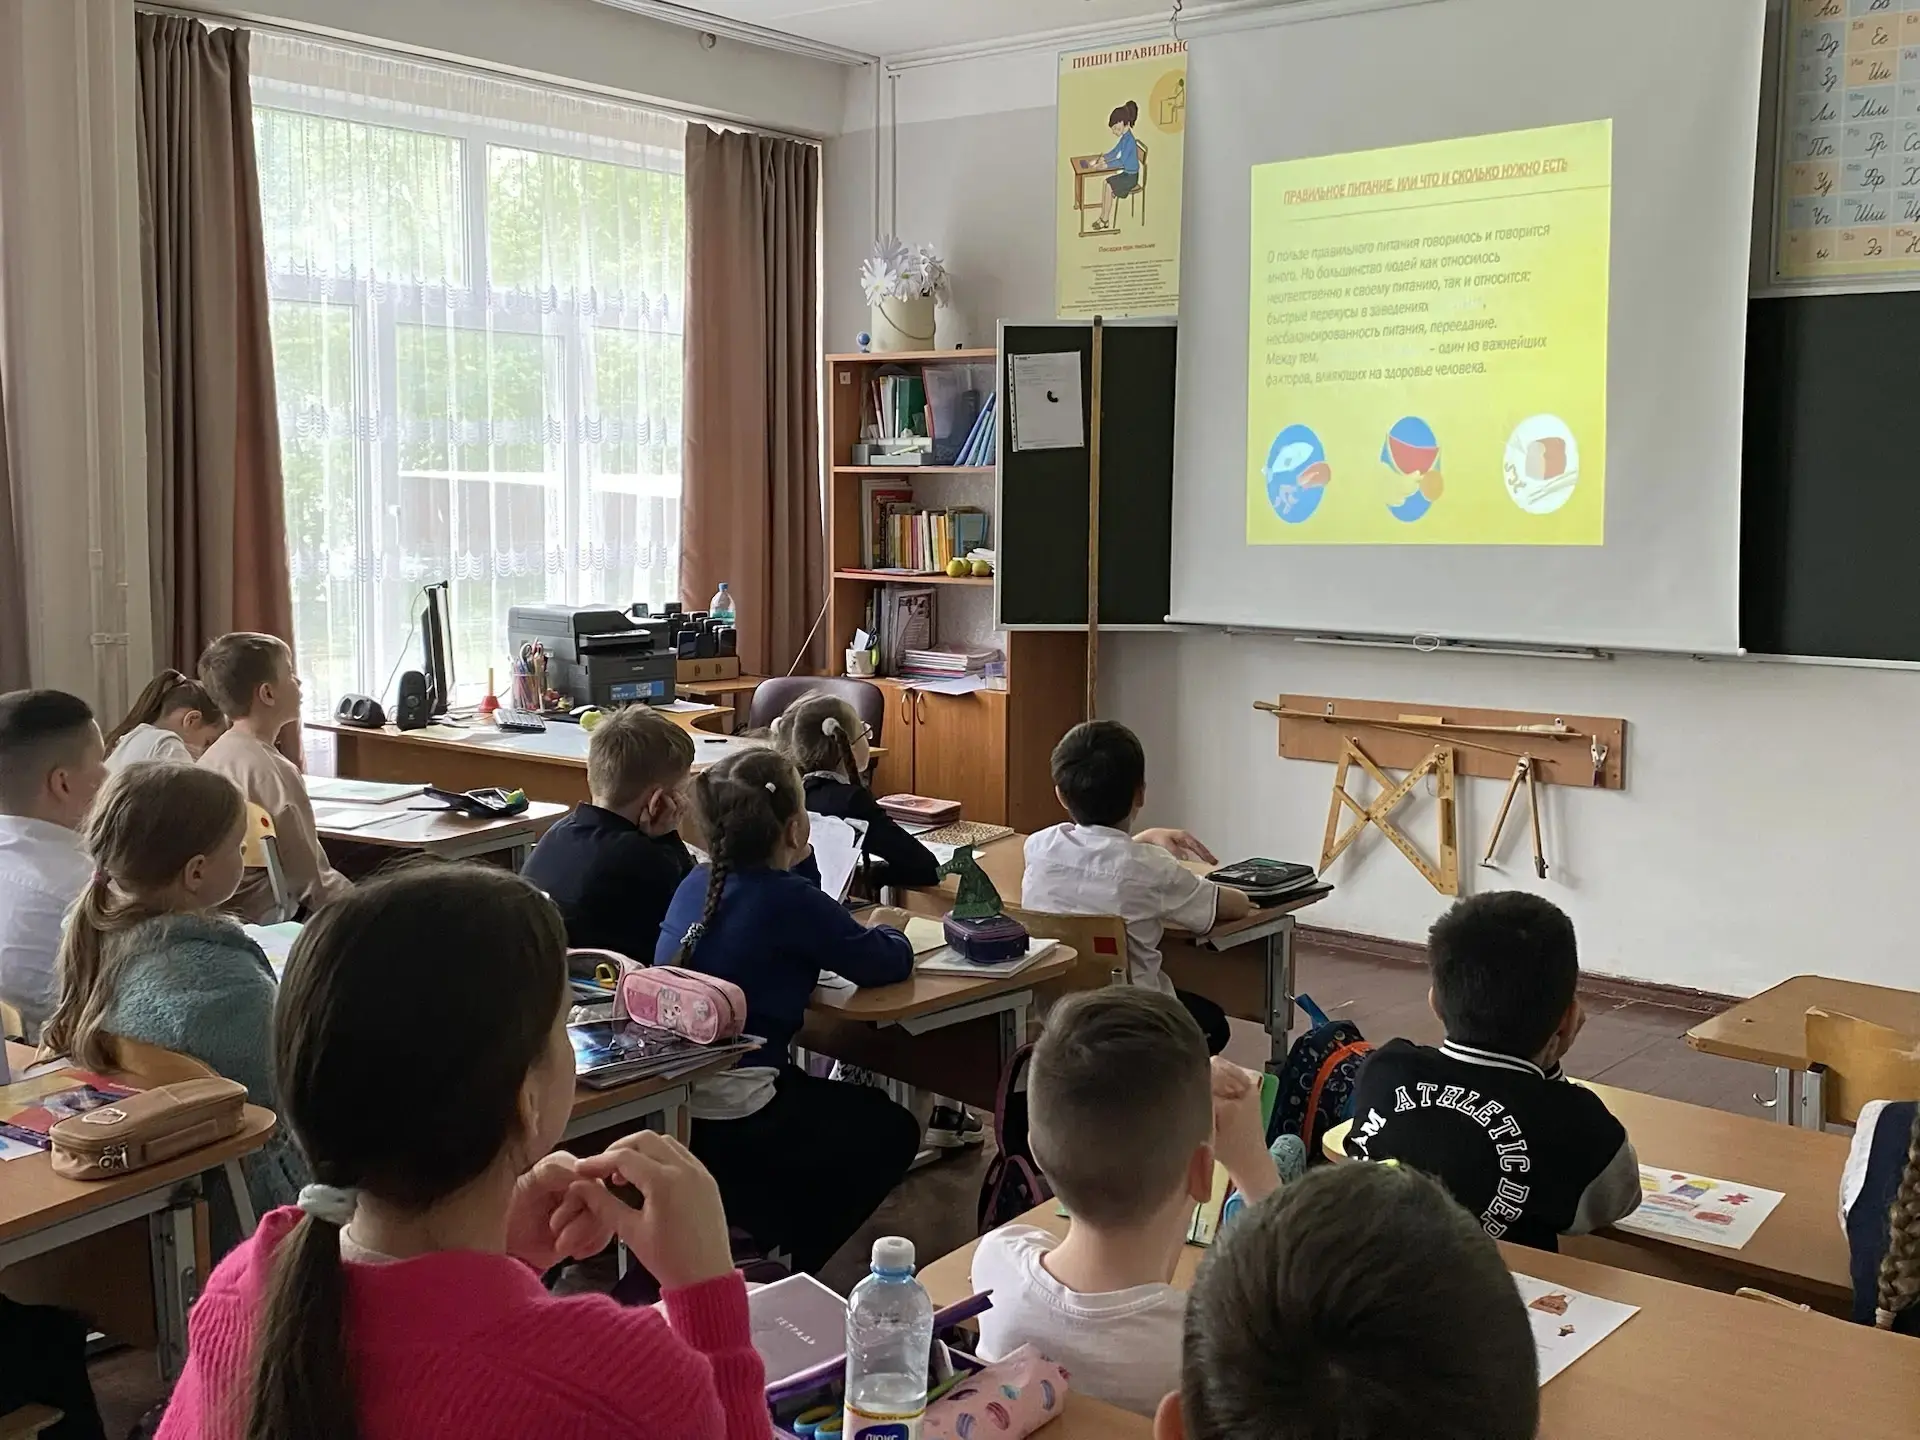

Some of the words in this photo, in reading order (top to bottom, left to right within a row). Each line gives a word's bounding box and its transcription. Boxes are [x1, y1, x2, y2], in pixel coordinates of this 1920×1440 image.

[1073, 53, 1112, 69] ПИШИ
[1284, 184, 1346, 205] ПРАВИЛЬНОЕ
[1397, 175, 1419, 192] ИЛИ
[1420, 172, 1440, 189] ЧТО
[1441, 171, 1451, 187] И
[1452, 165, 1500, 185] СКОЛЬКО
[1501, 160, 1541, 180] НУЖНО
[1542, 158, 1568, 174] ЕСТЬ
[1277, 249, 1310, 262] пользе
[1311, 242, 1375, 261] правильного
[1376, 238, 1420, 253] питания
[1422, 231, 1483, 248] говорилось
[1485, 231, 1492, 241] и
[1495, 224, 1550, 241] говорится
[1301, 267, 1315, 280] Но
[1316, 264, 1382, 280] большинство
[1385, 257, 1417, 273] людей
[1419, 258, 1438, 269] как
[1441, 251, 1501, 268] относилось
[1353, 283, 1391, 298] своему
[1392, 278, 1441, 293] питанию,
[1444, 276, 1461, 288] так
[1464, 276, 1471, 287] и
[1473, 271, 1532, 287] относится:
[1267, 310, 1308, 325] быстрые
[1310, 307, 1359, 323] перекусы
[1361, 306, 1367, 318] в
[1369, 302, 1429, 317] заведениях
[1382, 323, 1427, 337] питания,
[1430, 318, 1498, 335] переедание.
[1266, 352, 1297, 368] Между
[1438, 342, 1465, 355] один
[1467, 340, 1480, 352] из
[1482, 335, 1548, 352] важнейших
[1265, 372, 1313, 388] факторов,
[1315, 369, 1367, 382] влияющих
[1369, 367, 1382, 379] на
[1384, 365, 1433, 380] здоровье
[1435, 361, 1487, 376] человека.
[1394, 1082, 1530, 1173] ATHLETIC
[775, 1316, 816, 1345] ТЕТРАДЬ
